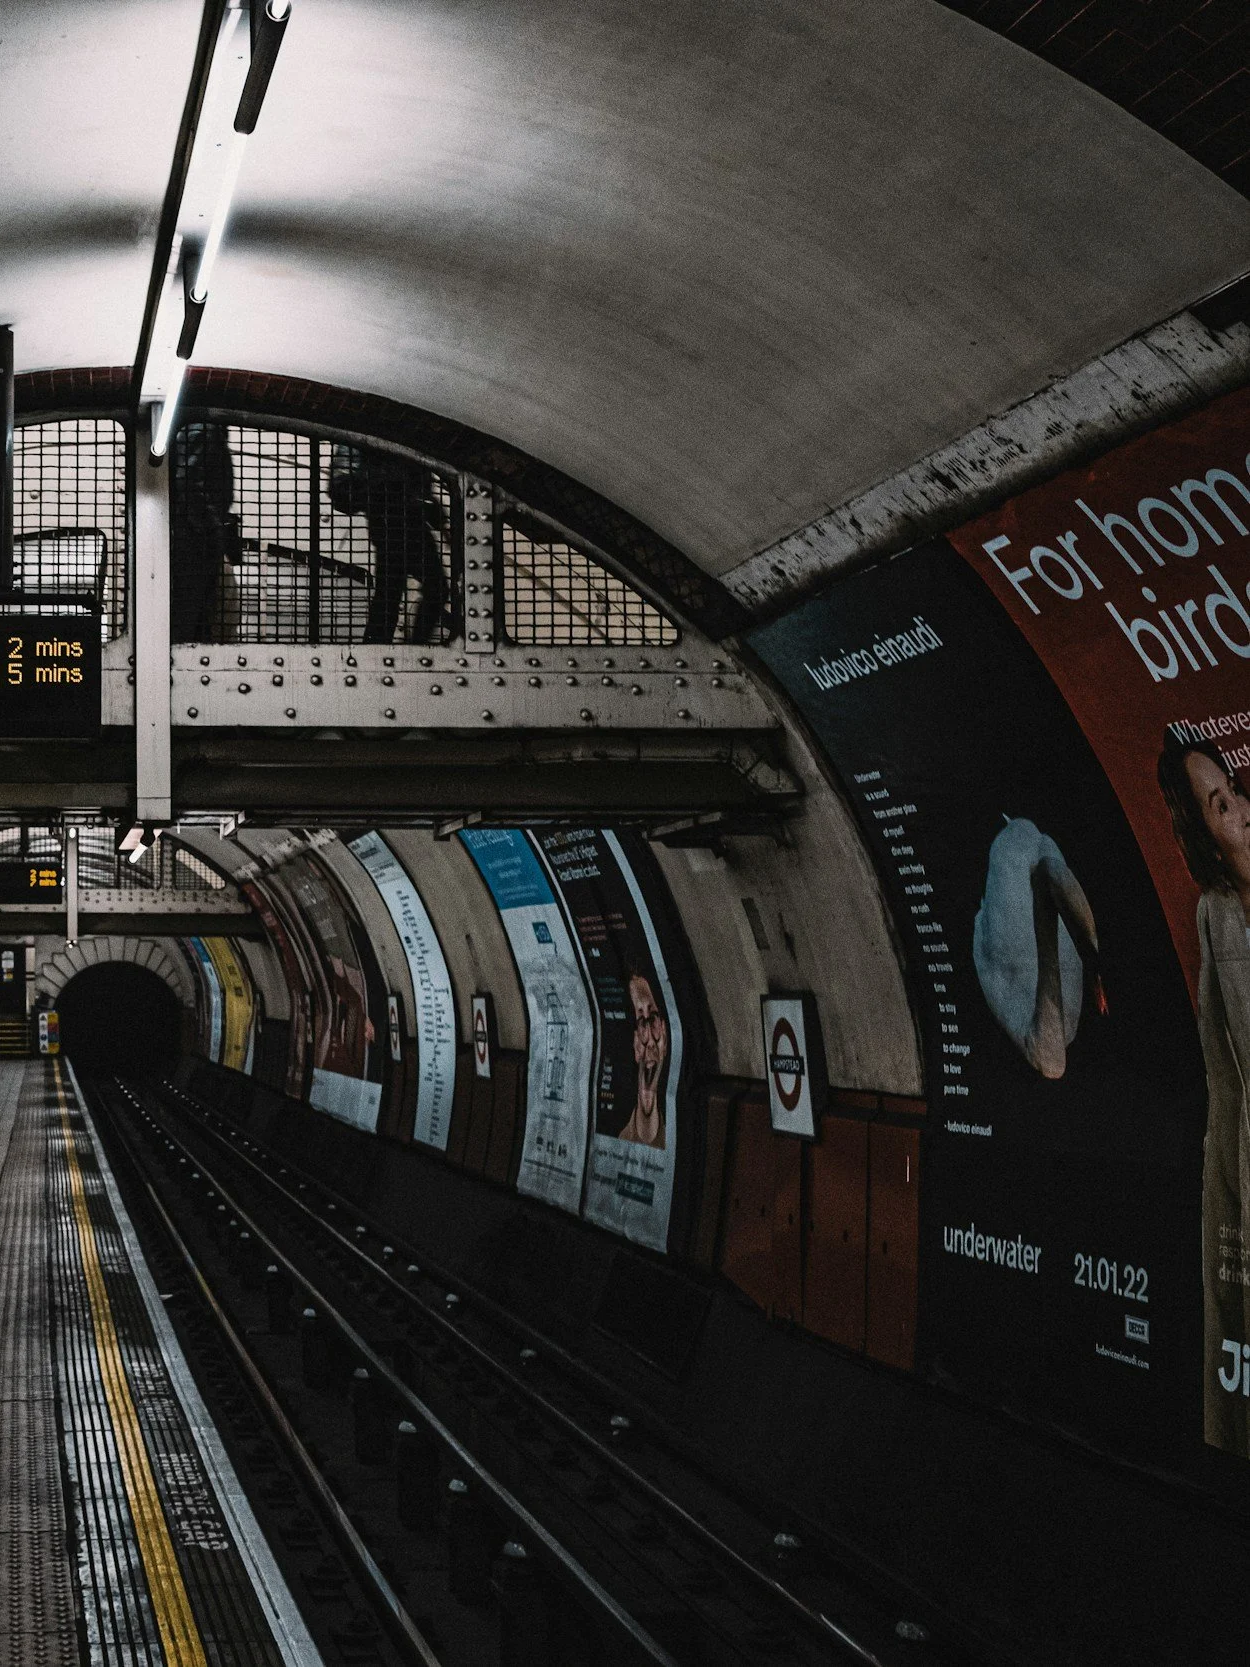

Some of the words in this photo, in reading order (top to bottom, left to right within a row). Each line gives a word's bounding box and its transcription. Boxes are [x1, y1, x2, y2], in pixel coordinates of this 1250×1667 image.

[981, 530, 1104, 615] For
[1074, 452, 1250, 576] hom
[7, 636, 23, 659] 2
[35, 636, 84, 658] mins
[1104, 564, 1250, 683] bird
[7, 662, 23, 685] 5
[35, 662, 84, 683] mins
[803, 648, 879, 691] ludovico
[873, 615, 944, 667] einaudi
[1167, 710, 1250, 746] Whateve
[943, 1222, 1042, 1274] underwater
[1073, 1252, 1149, 1303] 21.01.22
